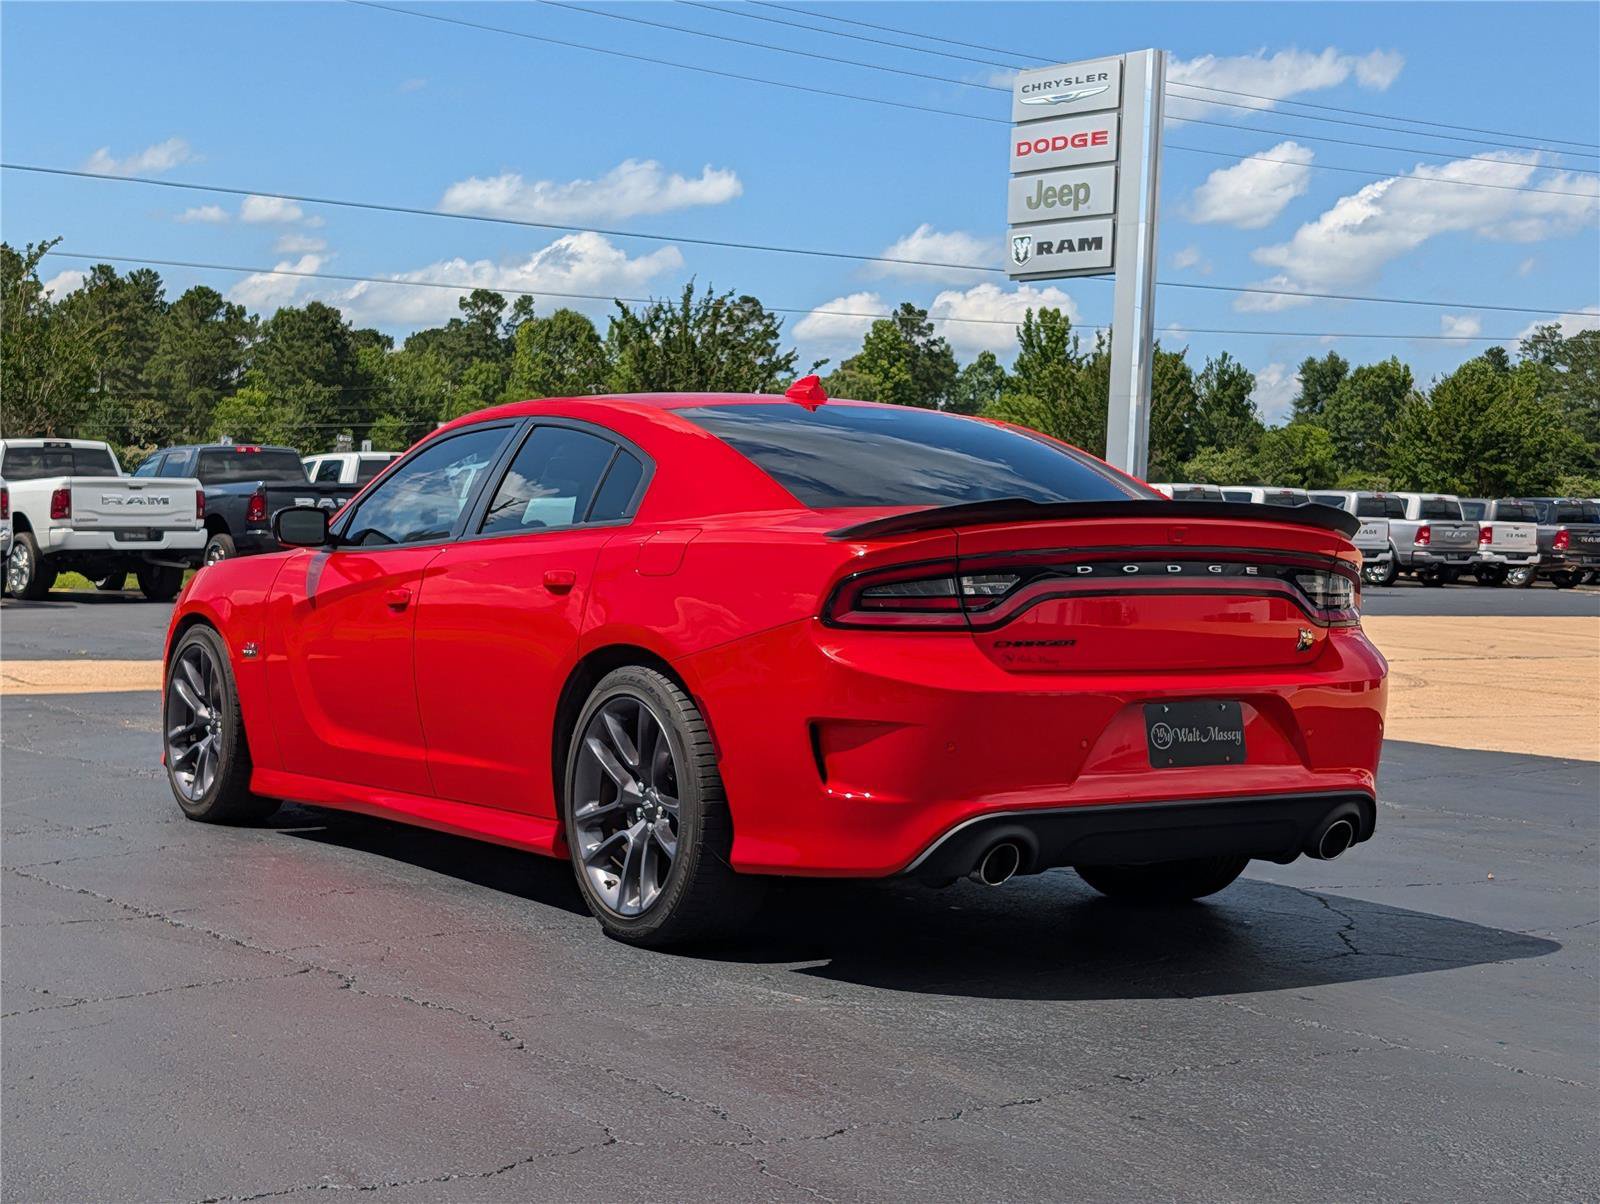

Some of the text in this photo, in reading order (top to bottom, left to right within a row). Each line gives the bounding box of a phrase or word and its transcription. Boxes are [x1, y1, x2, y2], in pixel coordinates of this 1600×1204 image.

[1021, 71, 1109, 94] CHRYSLER
[1016, 130, 1109, 157] DODGE
[1026, 179, 1091, 212] Jeep
[1036, 236, 1103, 256] RAM
[102, 494, 170, 505] RAM
[1076, 565, 1259, 575] DODGE
[993, 639, 1077, 648] CHARGER
[1172, 726, 1201, 743] Walt
[1201, 725, 1242, 746] Massey
